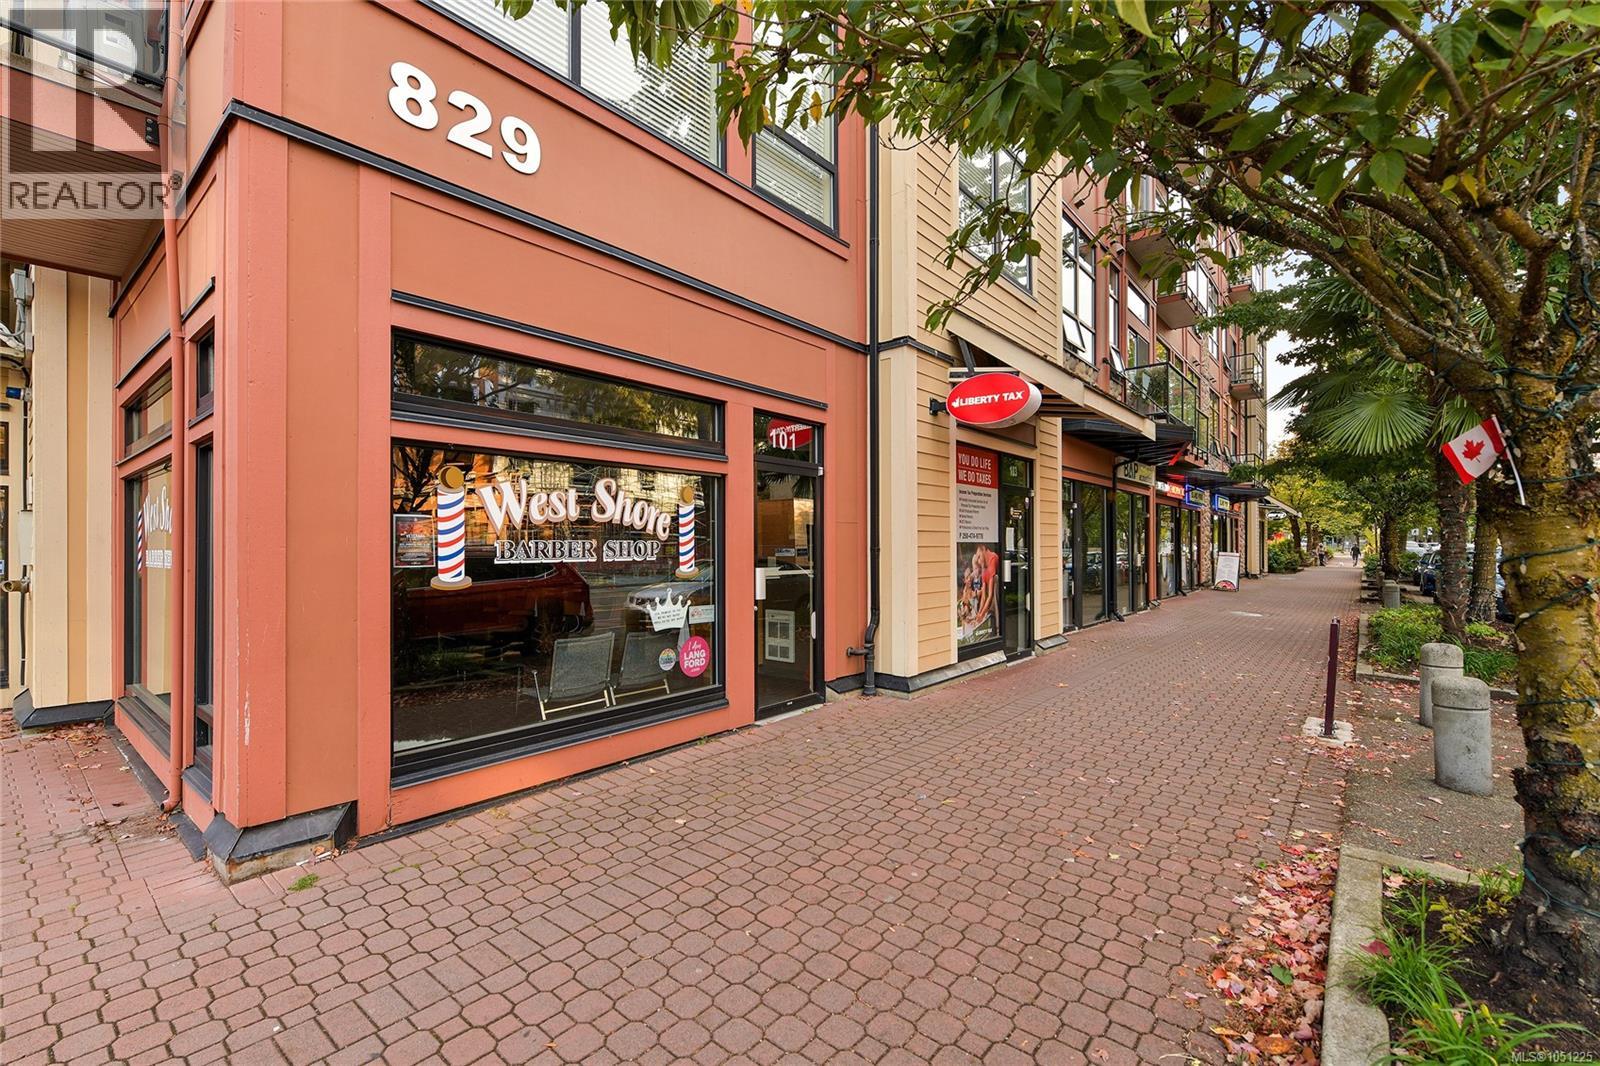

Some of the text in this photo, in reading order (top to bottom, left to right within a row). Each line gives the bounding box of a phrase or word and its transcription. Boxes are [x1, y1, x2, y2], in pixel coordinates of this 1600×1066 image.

[387, 61, 541, 175] 829
[960, 390, 1024, 406] LIBERTY TAX
[770, 429, 796, 451] 101
[958, 453, 991, 470] YOU DO LIFE
[958, 469, 992, 485] WE DO TAXES
[476, 478, 671, 541] West Shore
[494, 539, 661, 564] BARBER SHOP
[684, 649, 706, 660] LANG
[684, 658, 706, 669] FORD
